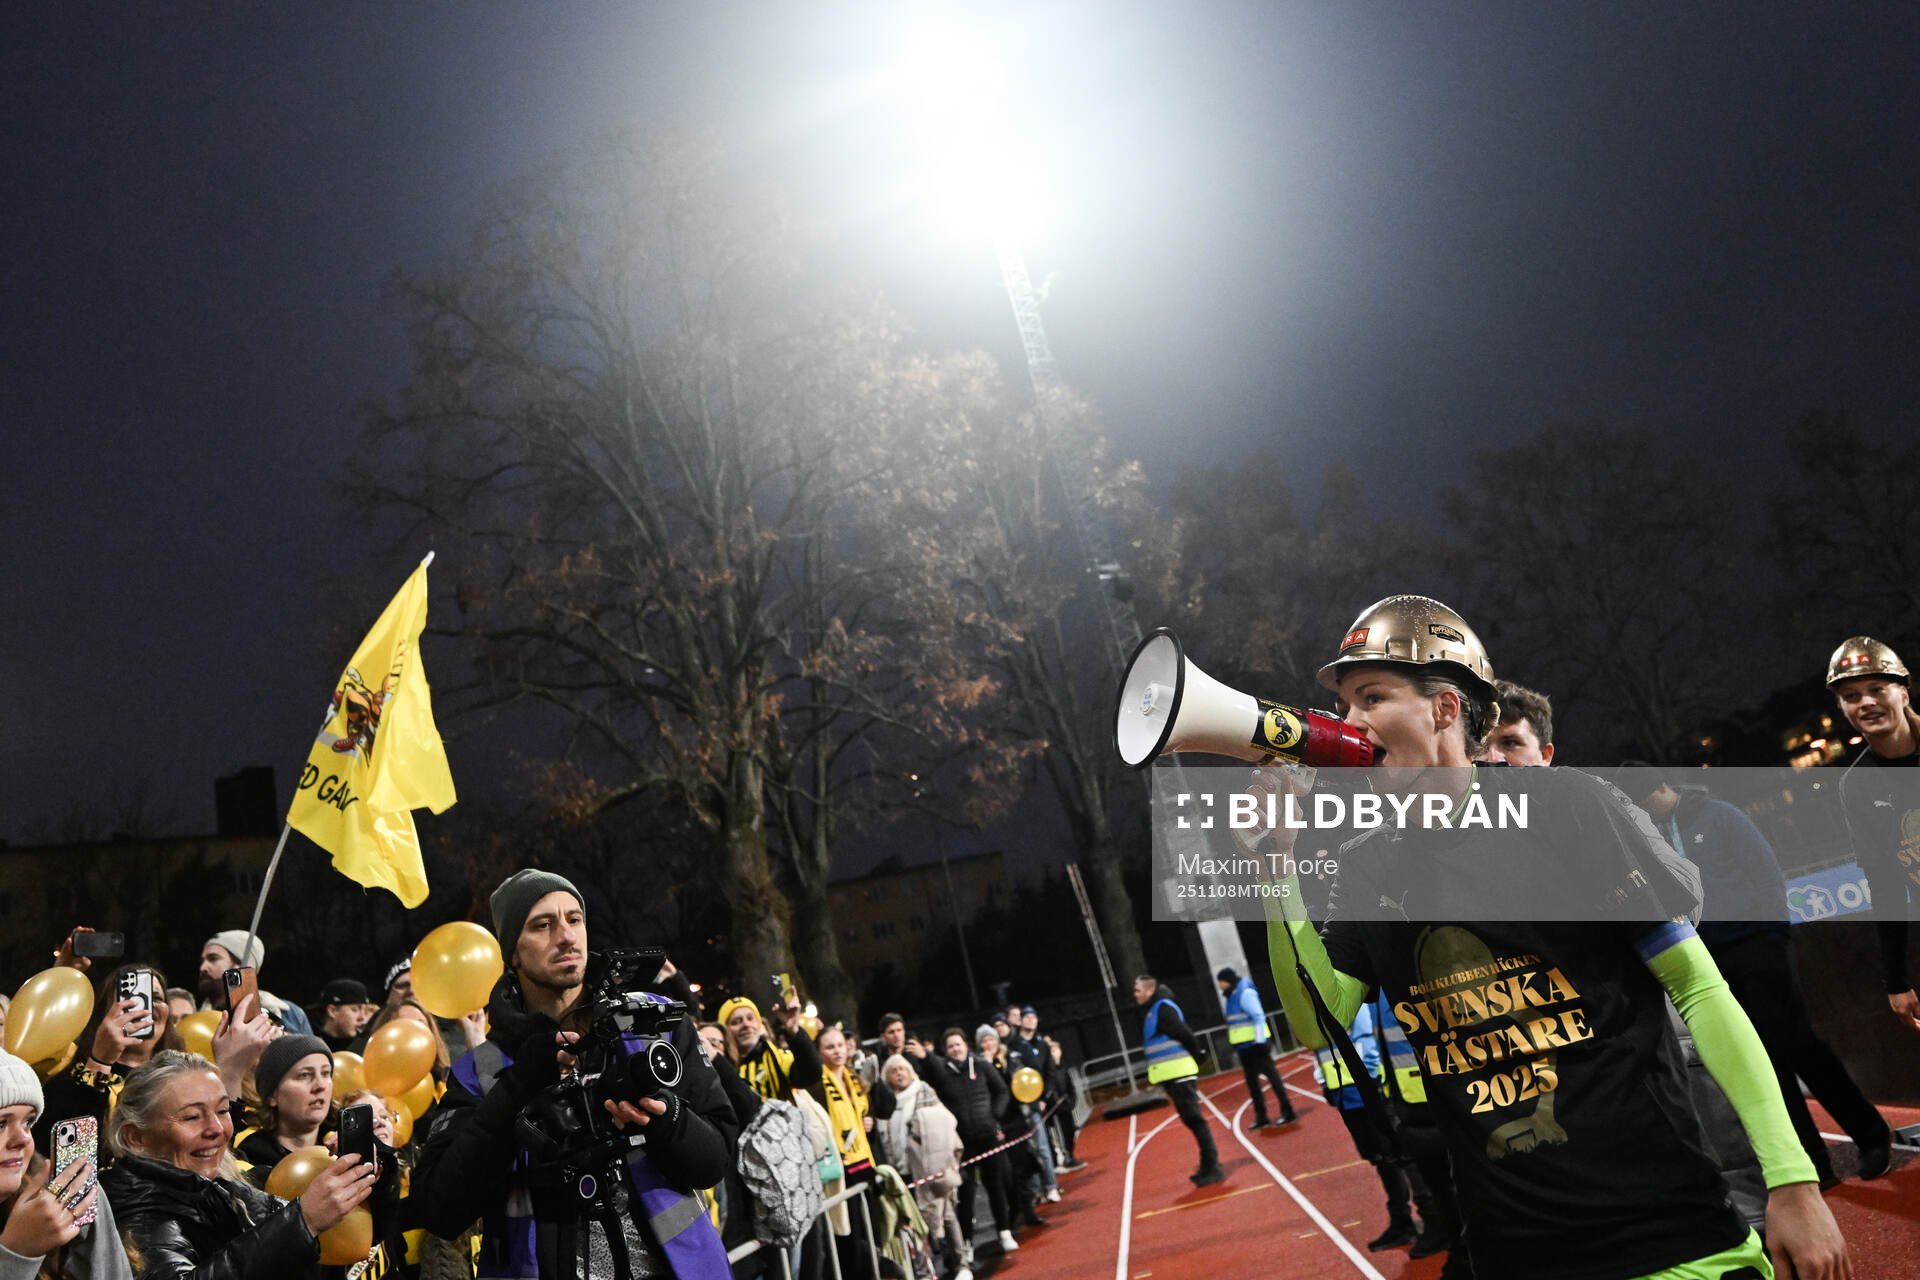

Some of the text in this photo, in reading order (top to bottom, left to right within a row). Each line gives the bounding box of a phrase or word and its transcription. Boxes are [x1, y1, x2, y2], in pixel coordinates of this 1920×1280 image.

[1394, 967, 1581, 1034] SVENSKA
[1421, 1008, 1594, 1076] MÄSTARE
[1466, 1056, 1558, 1114] 2025
